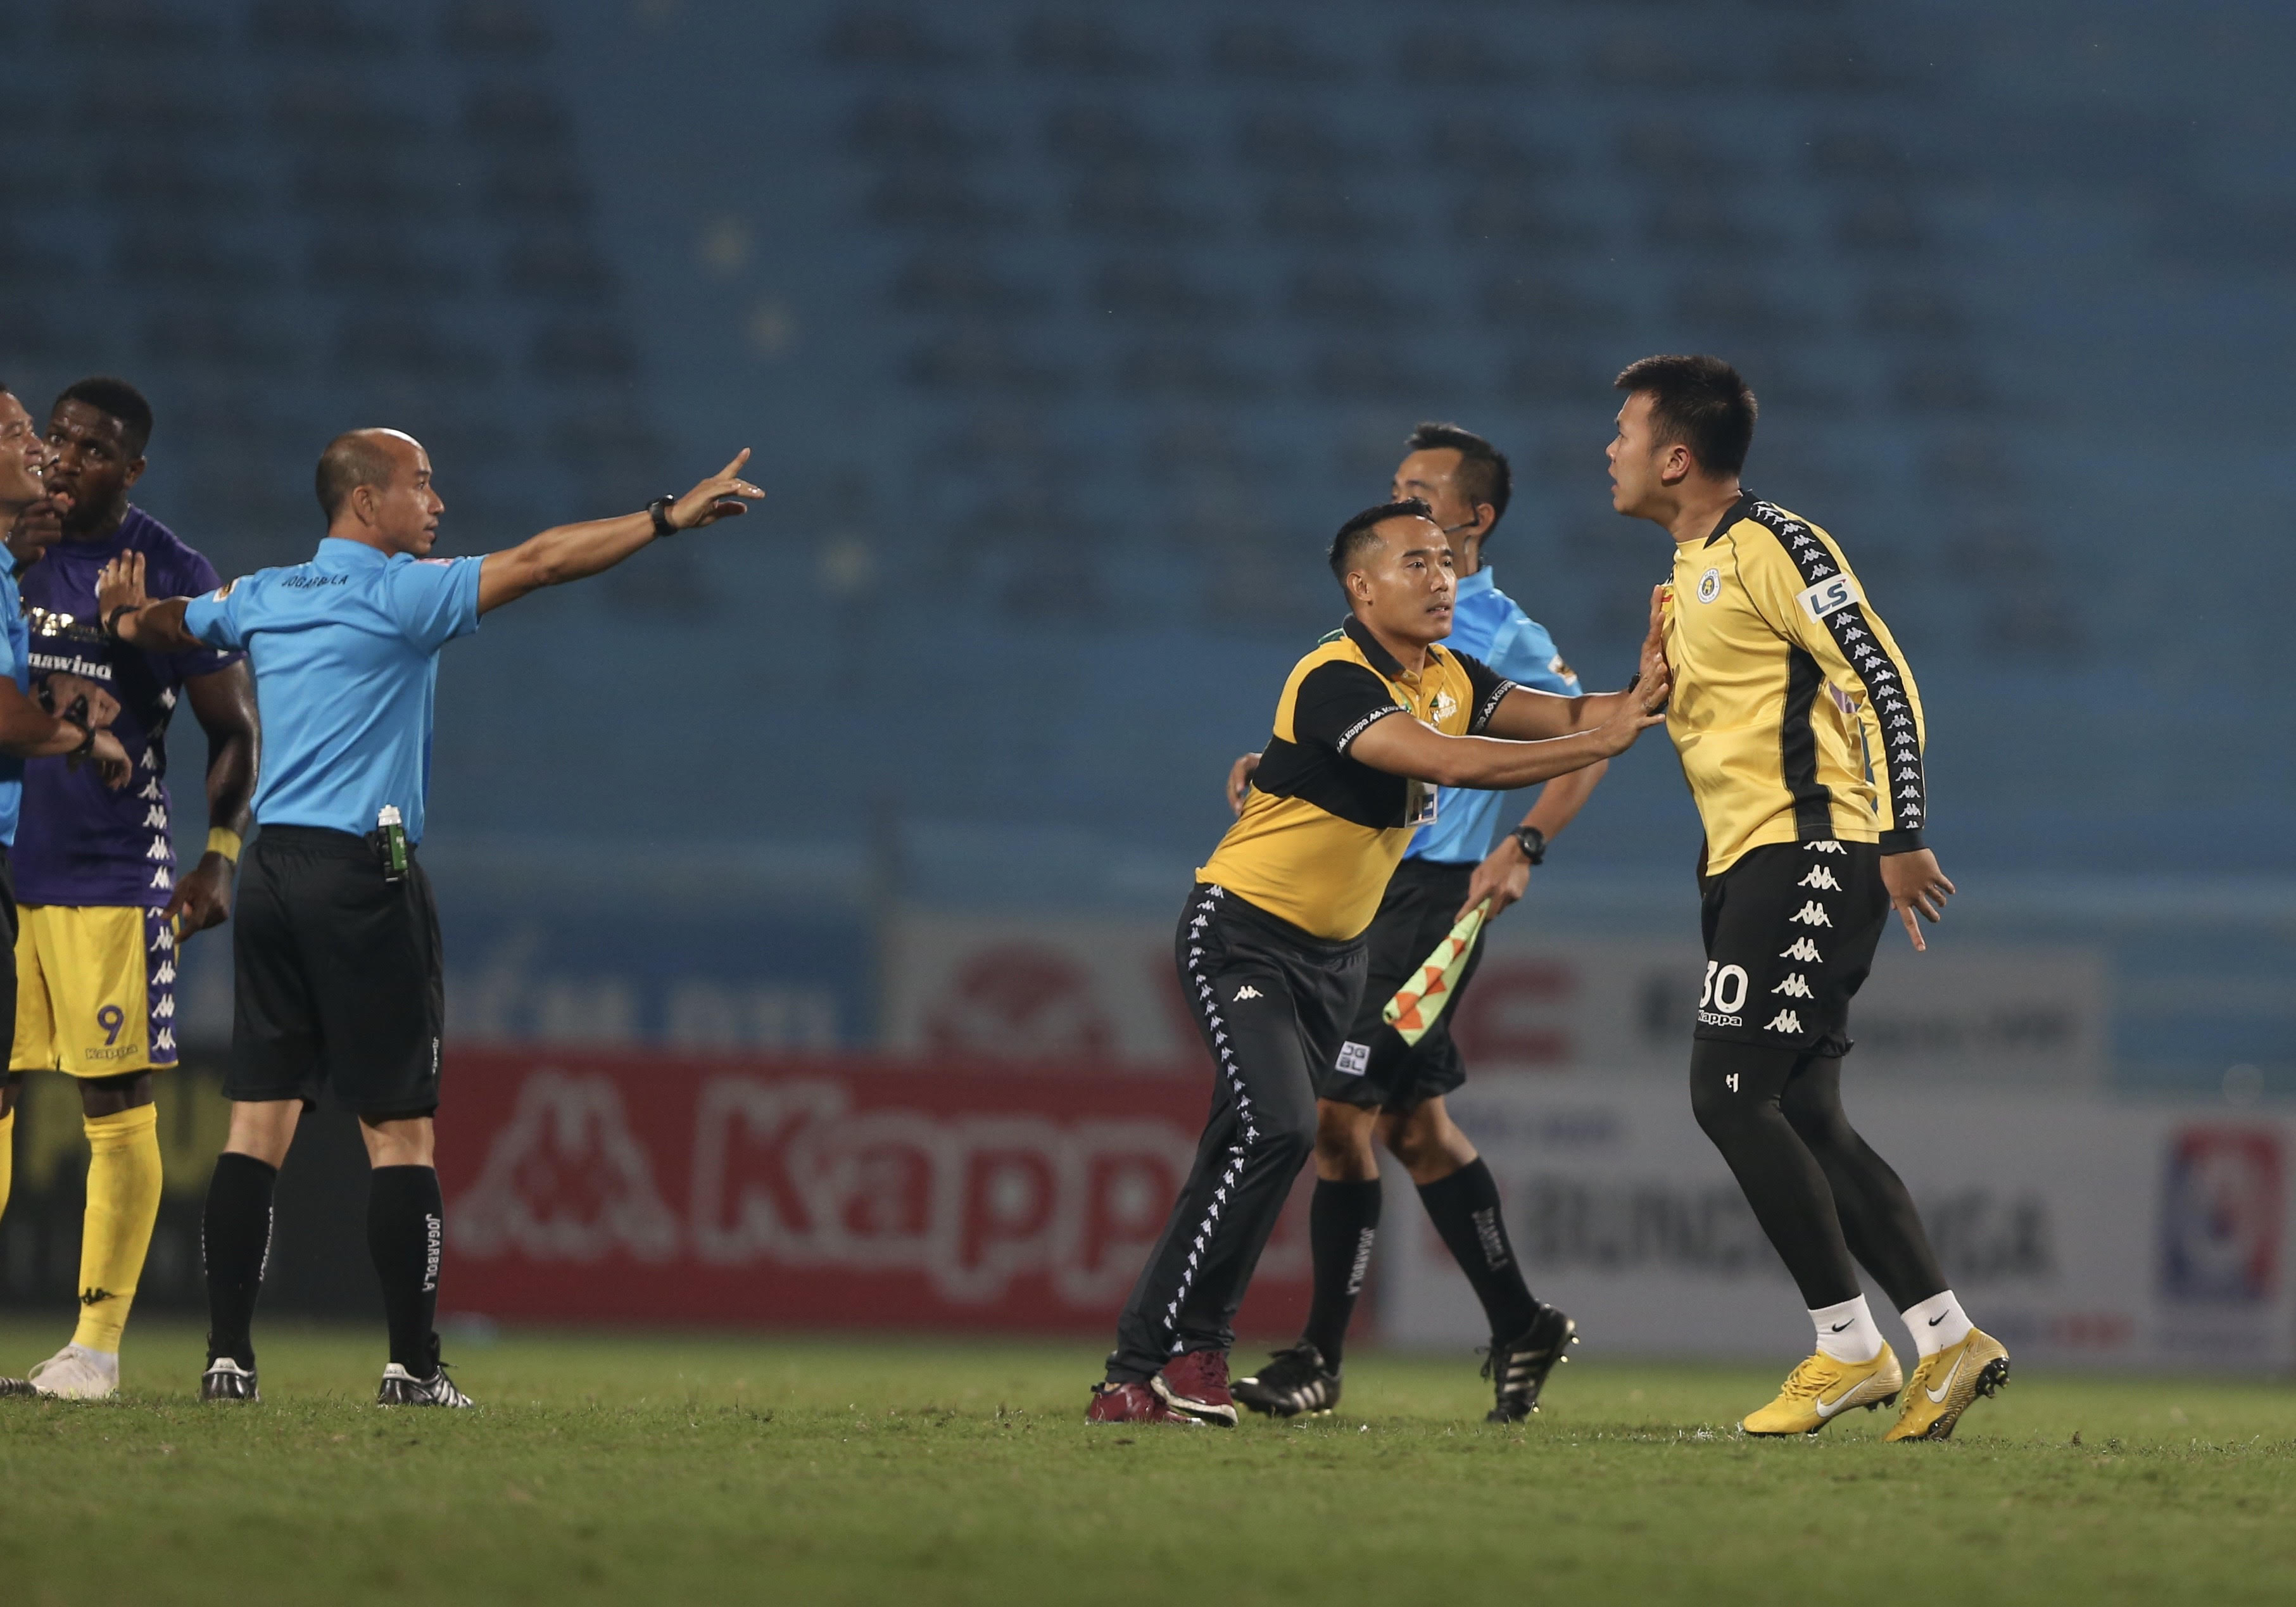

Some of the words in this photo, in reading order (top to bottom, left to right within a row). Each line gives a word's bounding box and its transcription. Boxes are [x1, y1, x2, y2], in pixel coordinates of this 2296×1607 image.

[281, 574, 349, 588] JOGARBLA
[1811, 582, 1848, 614] LS
[1345, 719, 1369, 740] Kappa
[98, 1005, 124, 1045] 9
[1698, 1010, 1742, 1026] Kappa
[85, 1044, 138, 1061] Kappa
[422, 1213, 441, 1292] JOGARBOLA
